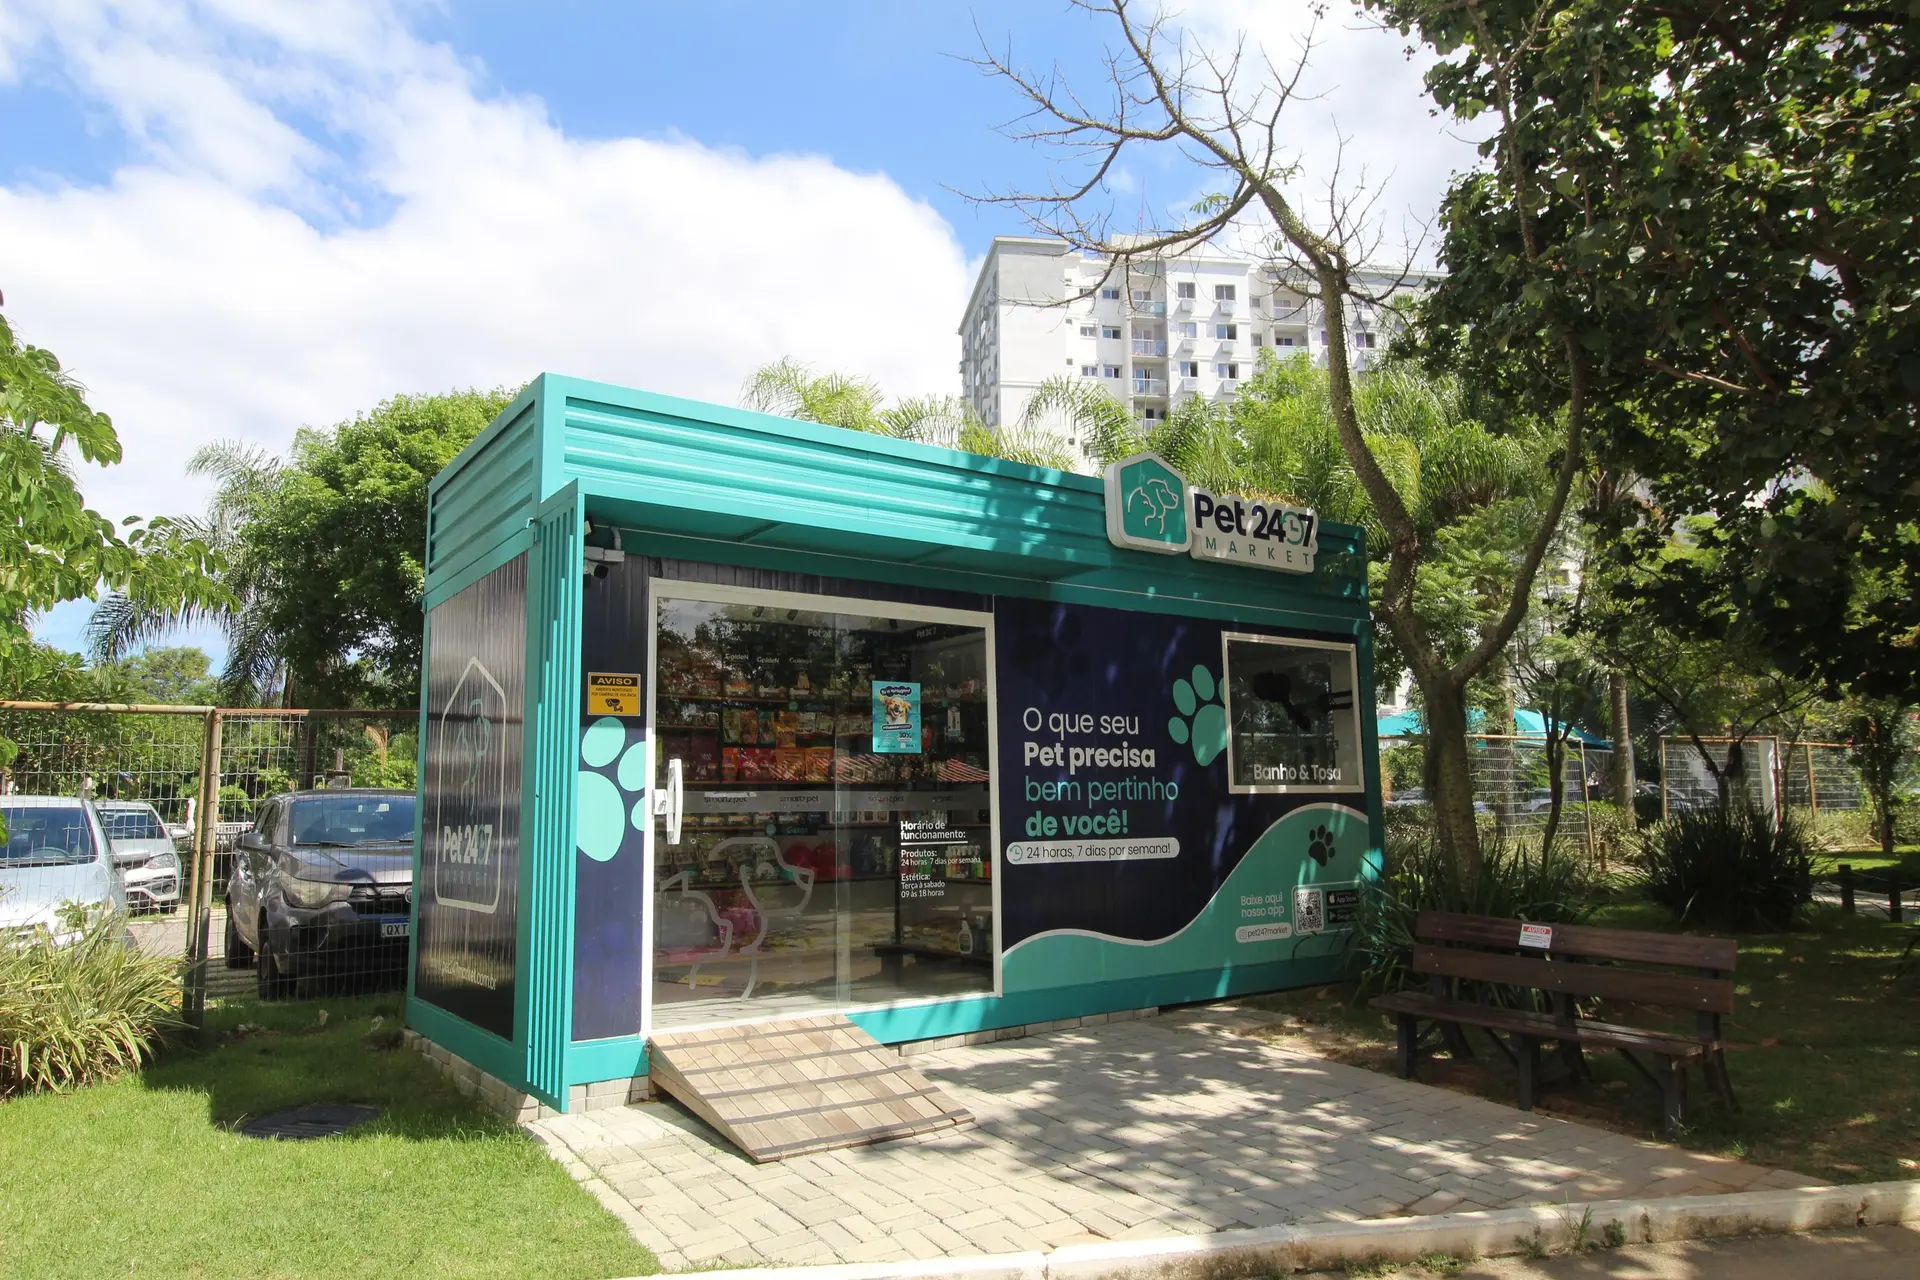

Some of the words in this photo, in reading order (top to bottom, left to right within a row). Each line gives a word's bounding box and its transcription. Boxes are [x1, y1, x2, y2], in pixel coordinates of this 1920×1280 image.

[1194, 493, 1247, 536] Pet
[1205, 536, 1309, 565] MARKET
[597, 677, 632, 685] AVISO
[1023, 707, 1043, 732] O
[1049, 712, 1094, 741] que
[1100, 715, 1139, 735] seu
[1024, 742, 1064, 766] Pet
[1069, 741, 1156, 775] precisa
[1253, 763, 1297, 781] Banho
[1299, 765, 1309, 780] &
[1311, 764, 1342, 781] Tosa
[1025, 775, 1081, 802] bem
[1088, 775, 1179, 809] pertinho
[900, 820, 934, 831] Horário
[935, 820, 946, 829] de
[1025, 810, 1058, 837] de
[1062, 808, 1128, 836] você!
[900, 830, 966, 840] funcionamento:
[443, 825, 463, 864] Pet
[1026, 846, 1040, 859] 24
[1042, 845, 1075, 859] horas,
[1077, 846, 1083, 857] 7
[1085, 844, 1106, 857] dias
[1108, 846, 1126, 859] por
[1127, 842, 1171, 855] semana!
[901, 849, 938, 858] Produtos:
[901, 858, 910, 867] 24
[930, 857, 934, 865] 7
[934, 856, 947, 865] dias
[947, 857, 959, 866] por
[901, 872, 931, 882] Estética:
[901, 882, 918, 890] Terça
[901, 890, 910, 898] 09
[927, 889, 945, 897] horas
[1240, 895, 1263, 906] Baixe
[1265, 891, 1283, 906] aqui
[1241, 908, 1266, 918] nosso
[1267, 905, 1285, 918] app
[1526, 926, 1547, 935] AVISO
